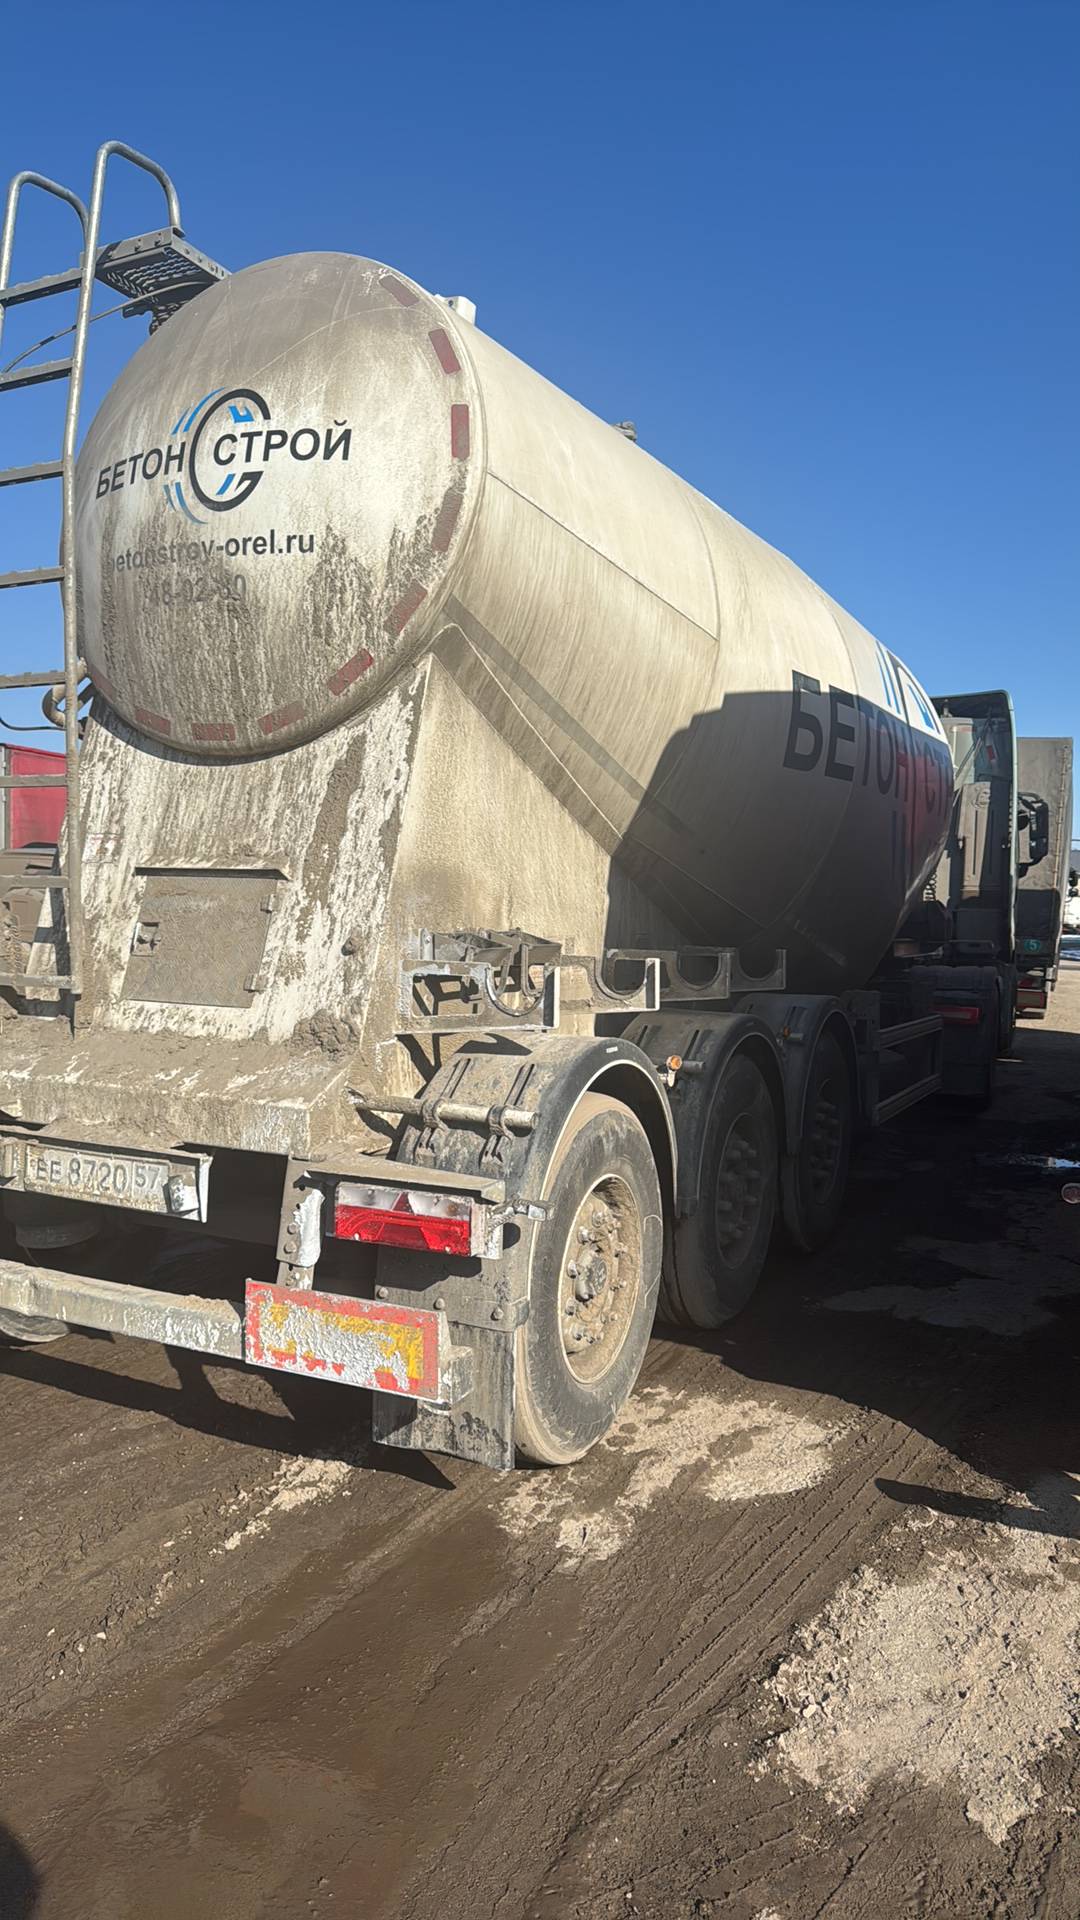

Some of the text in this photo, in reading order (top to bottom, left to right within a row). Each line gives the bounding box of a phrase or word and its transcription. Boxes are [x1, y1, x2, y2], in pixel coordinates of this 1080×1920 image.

[96, 419, 352, 499] БЕТОН СТРОЙ
[783, 669, 908, 803] БЕТОН
